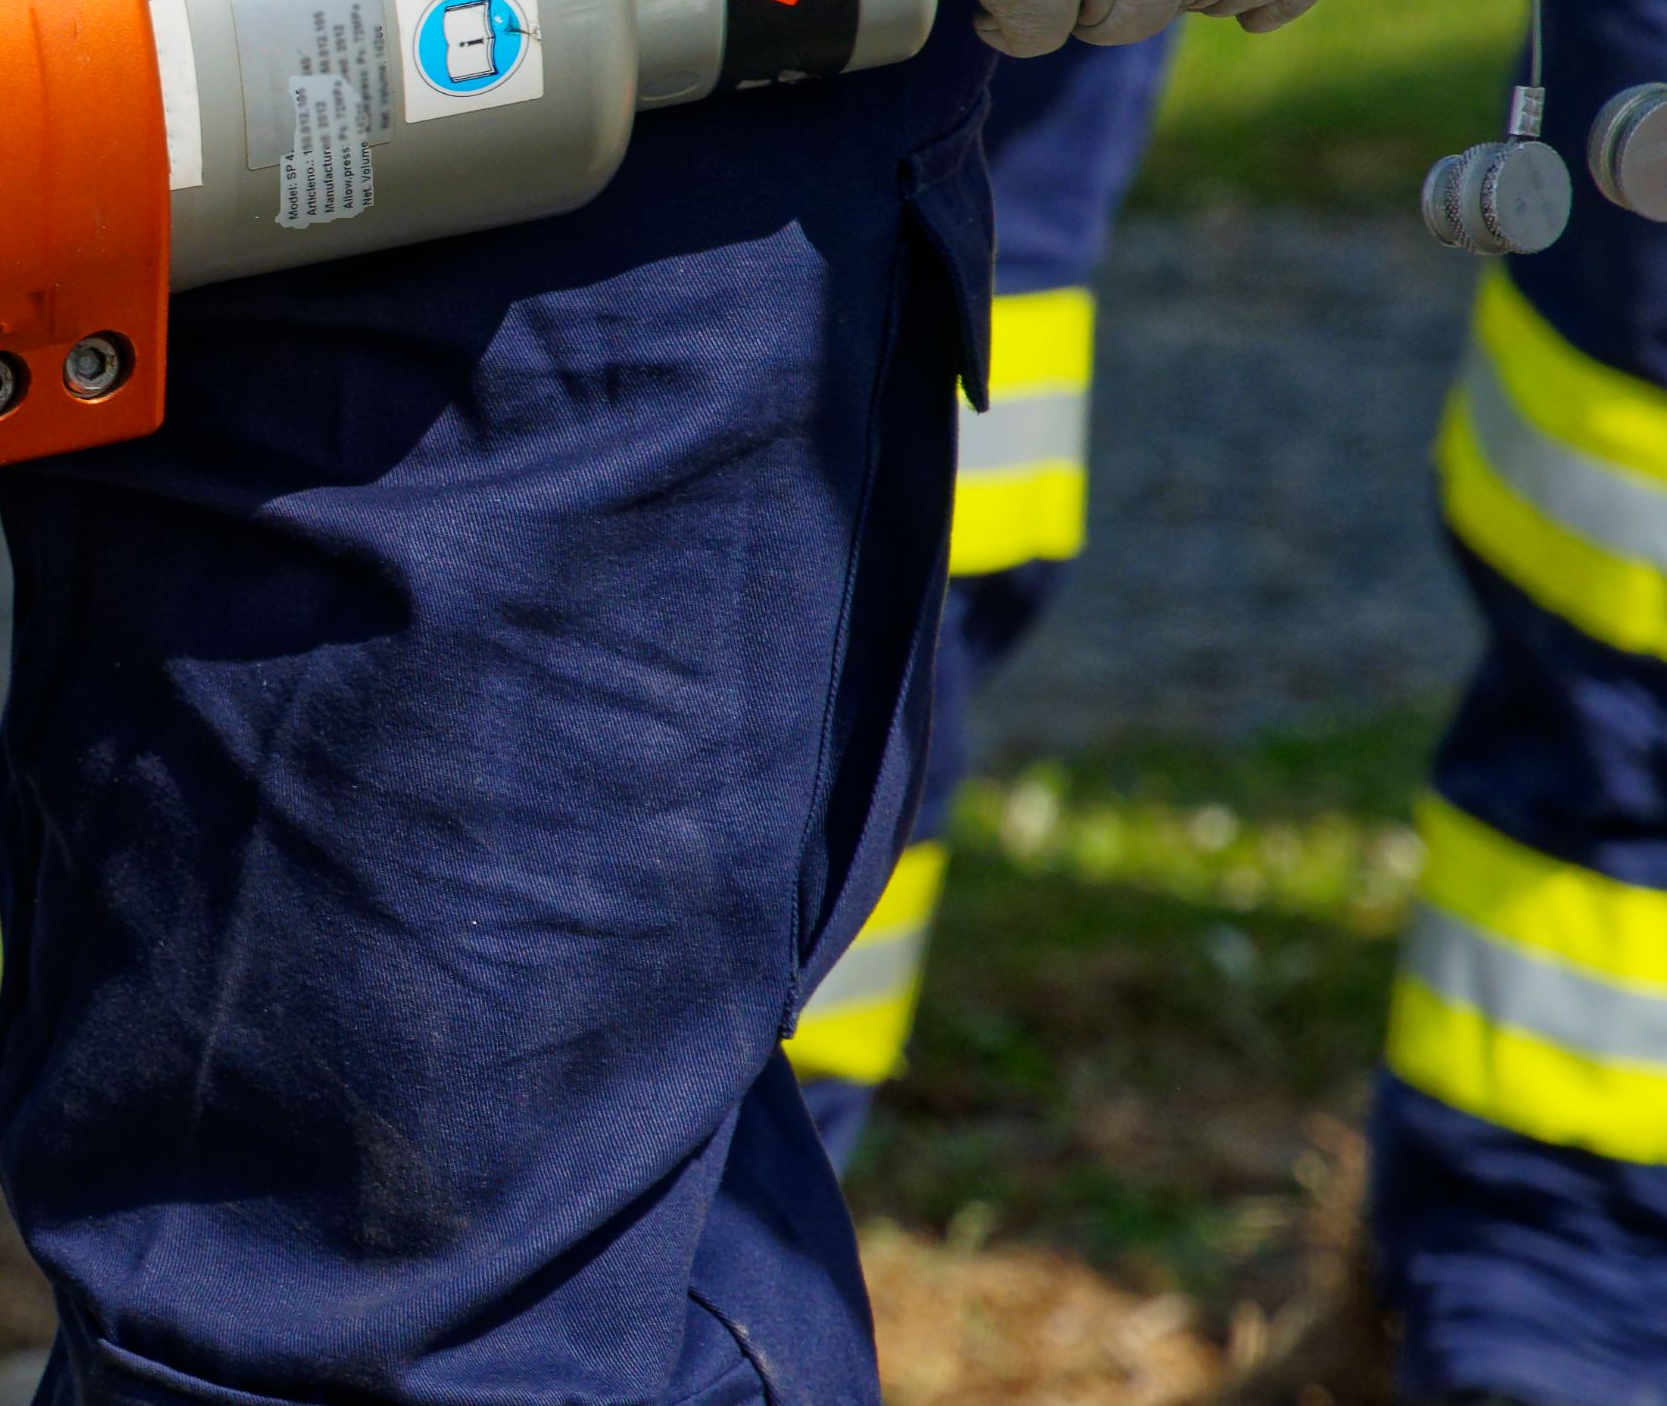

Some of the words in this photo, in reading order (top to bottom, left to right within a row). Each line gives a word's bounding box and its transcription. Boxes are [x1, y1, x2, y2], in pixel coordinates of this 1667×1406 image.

[285, 165, 297, 180] SP
[306, 160, 317, 215] Articleno.:
[288, 182, 299, 220] Model:
